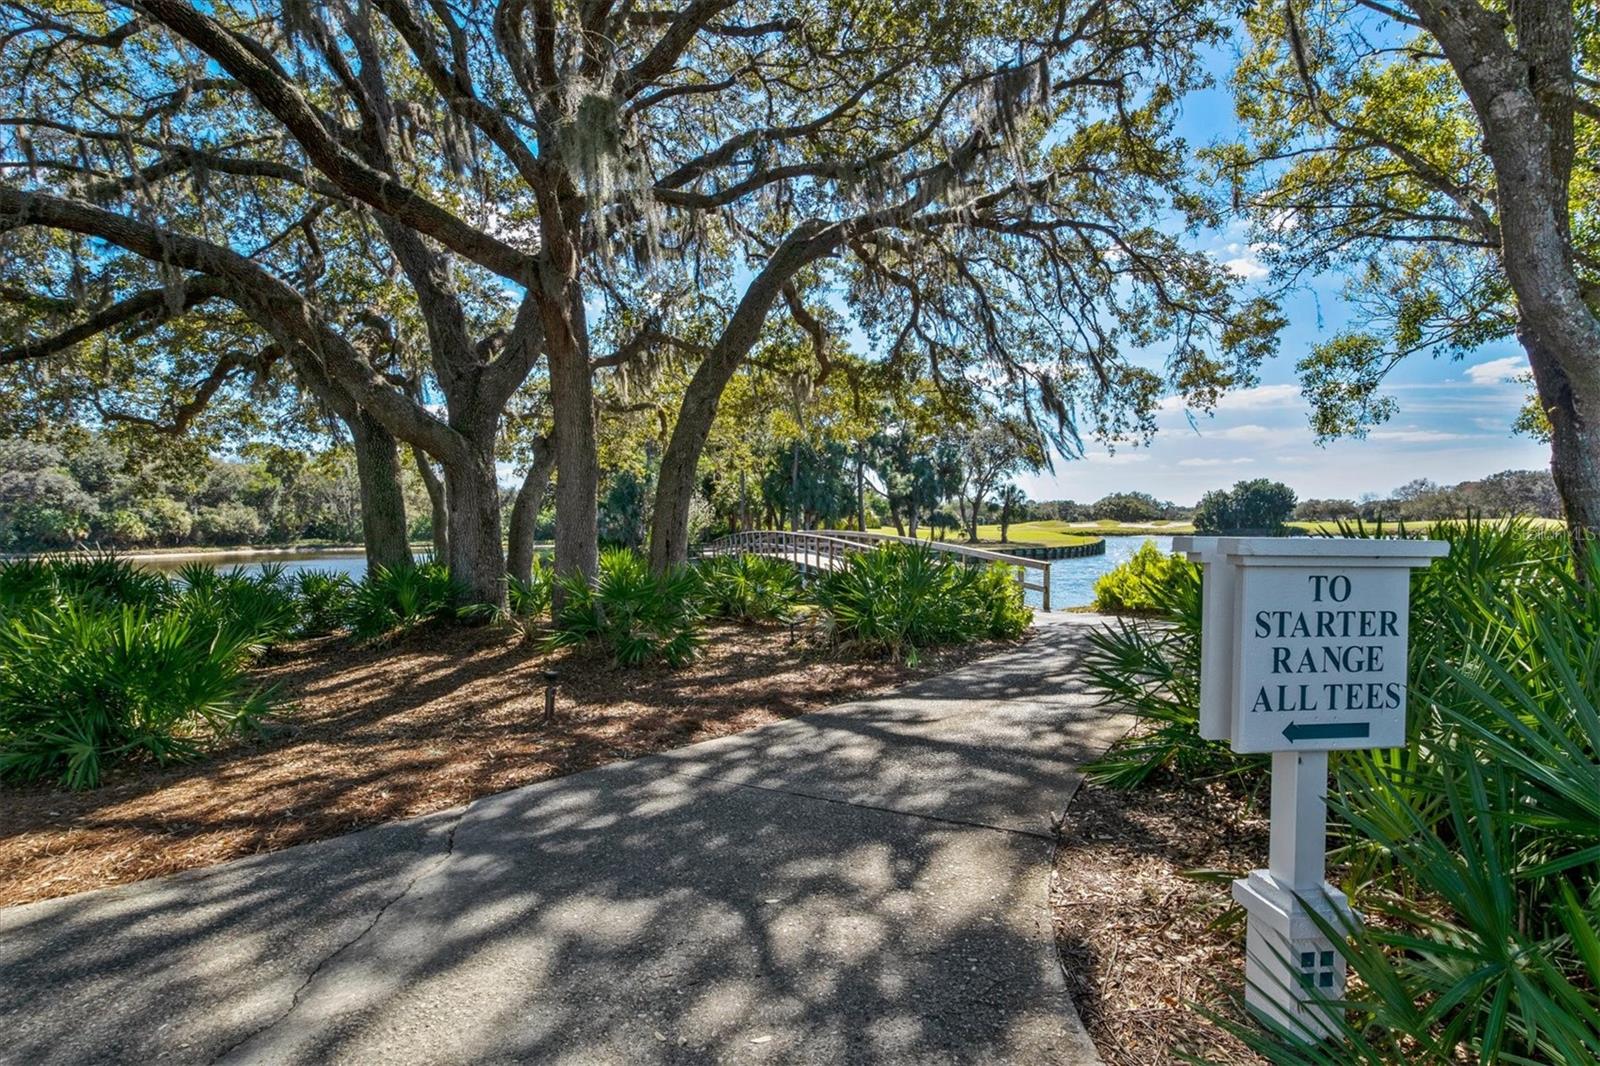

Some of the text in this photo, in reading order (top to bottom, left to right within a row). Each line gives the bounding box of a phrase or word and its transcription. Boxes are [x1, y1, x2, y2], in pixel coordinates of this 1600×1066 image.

[1308, 575, 1352, 603] TO
[1255, 611, 1399, 638] STARTER
[1271, 646, 1384, 674] RANGE
[1251, 682, 1401, 713] ALL TEES
